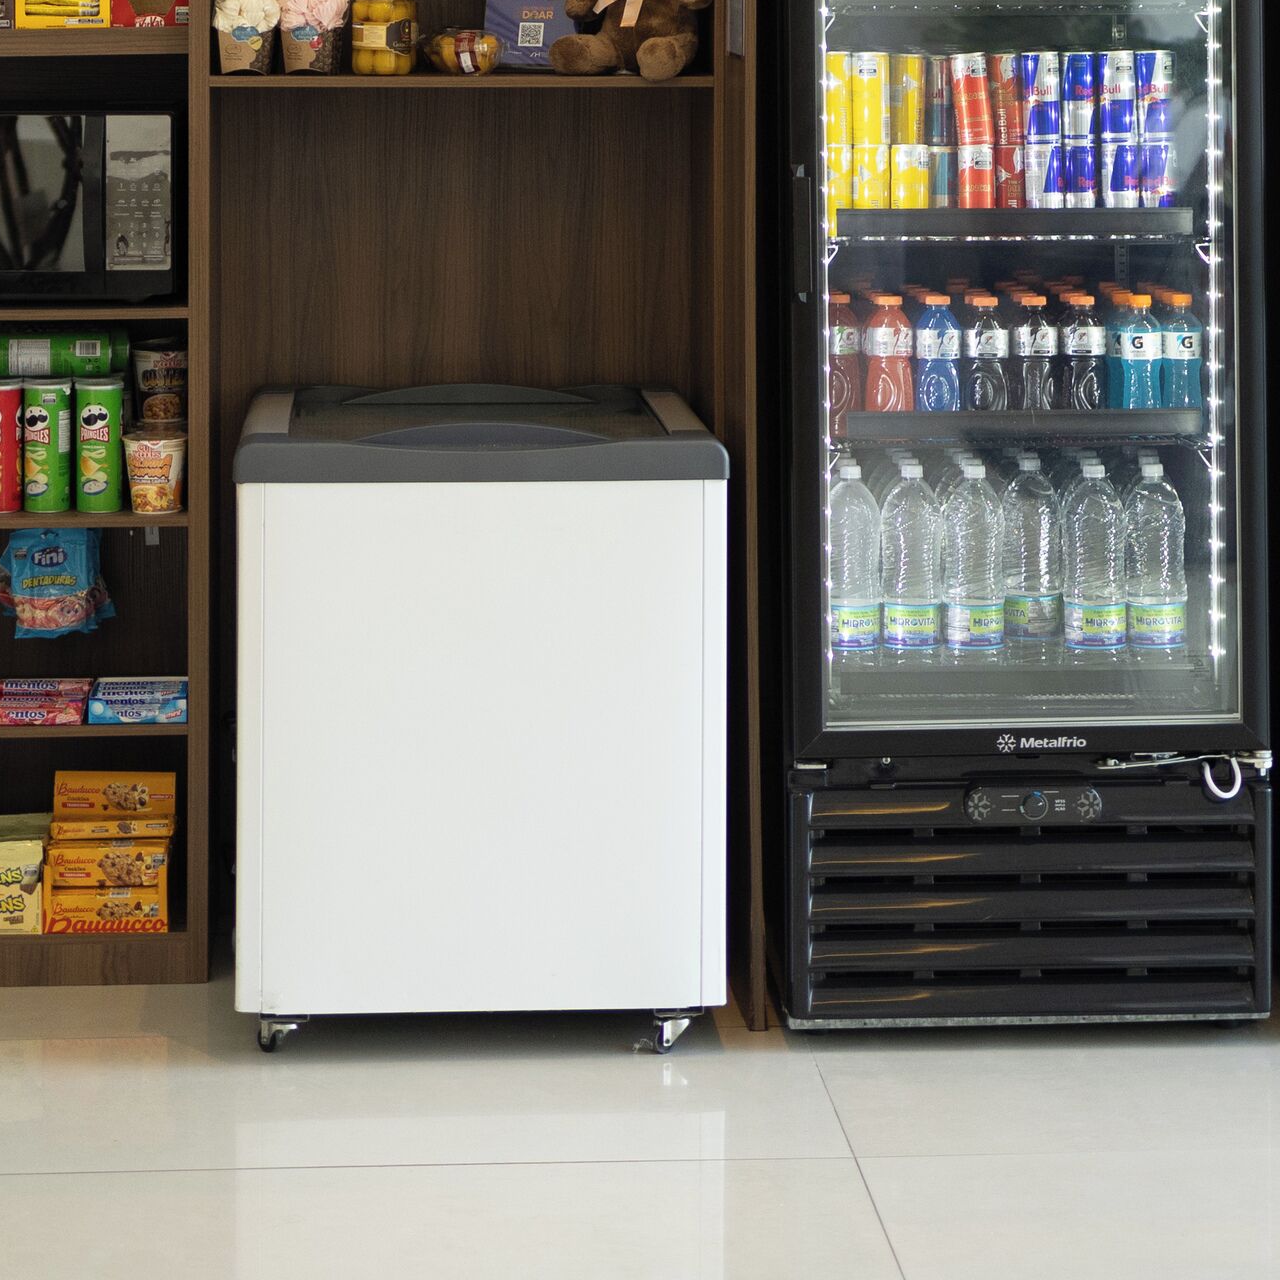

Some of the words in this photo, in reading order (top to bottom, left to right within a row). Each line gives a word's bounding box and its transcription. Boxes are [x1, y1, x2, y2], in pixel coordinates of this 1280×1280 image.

[522, 11, 554, 20] DOAR
[1033, 85, 1052, 96] Bull
[998, 108, 1007, 126] Bull
[999, 126, 1007, 145] Red
[1131, 335, 1144, 350] G
[80, 427, 109, 442] PRINGLES
[33, 547, 65, 566] Fini
[22, 575, 77, 589] DENTADURAS
[889, 616, 935, 627] HIDROVITA
[1136, 615, 1182, 626] HIDROVITA
[4, 680, 58, 691] mentos
[6, 709, 46, 720] entos
[1020, 736, 1087, 749] Metalfrio
[57, 783, 101, 797] Bauducco
[54, 853, 97, 867] Bauducco
[53, 903, 96, 916] Bauducco
